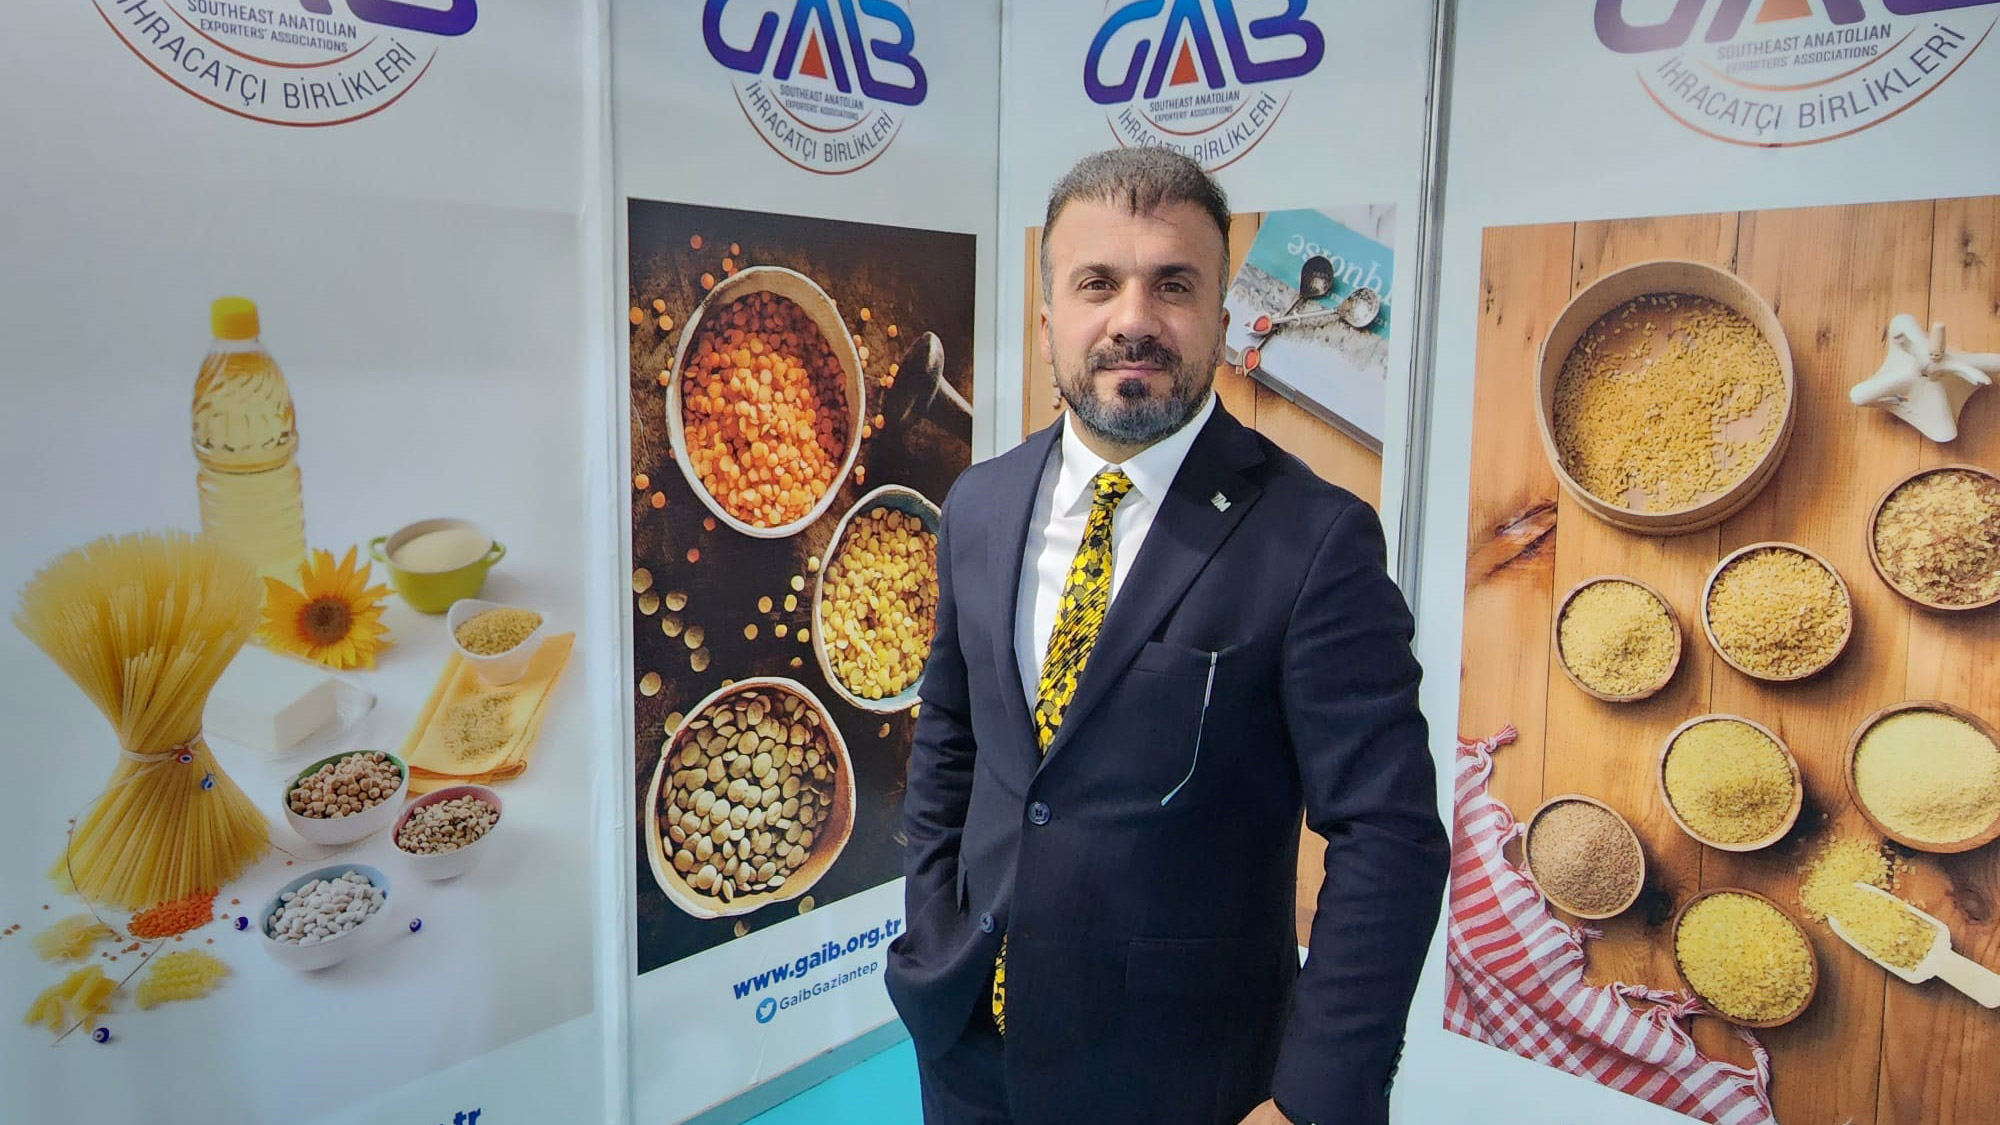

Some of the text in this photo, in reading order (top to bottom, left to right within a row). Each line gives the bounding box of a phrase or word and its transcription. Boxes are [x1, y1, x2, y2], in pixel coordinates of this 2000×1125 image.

[187, 0, 274, 26] SOUTHEAST
[278, 12, 357, 39] ANATOLIAN
[116, 0, 267, 106] HRACATÇI
[284, 37, 417, 109] BİRLİKLERİ
[270, 30, 348, 52] ASSOCIATIONS
[1717, 36, 1800, 60] SOUTHEAST
[1803, 23, 1892, 49] ANATOLIAN
[1793, 45, 1878, 65] ASSOCIATIONS
[780, 84, 864, 110] SOUTHEAST ANATOLIAN
[1656, 52, 1781, 135] İHRACATÇI
[1799, 22, 1966, 129] BİRLİKLERİ
[1149, 90, 1240, 112] SOUTHEAST ANATOLIAN
[745, 80, 895, 163] İHRACATÇI BİRLİKLERİ
[733, 918, 902, 999] www.gaib.org.tr
[779, 961, 878, 1010] GaibGaziantep
